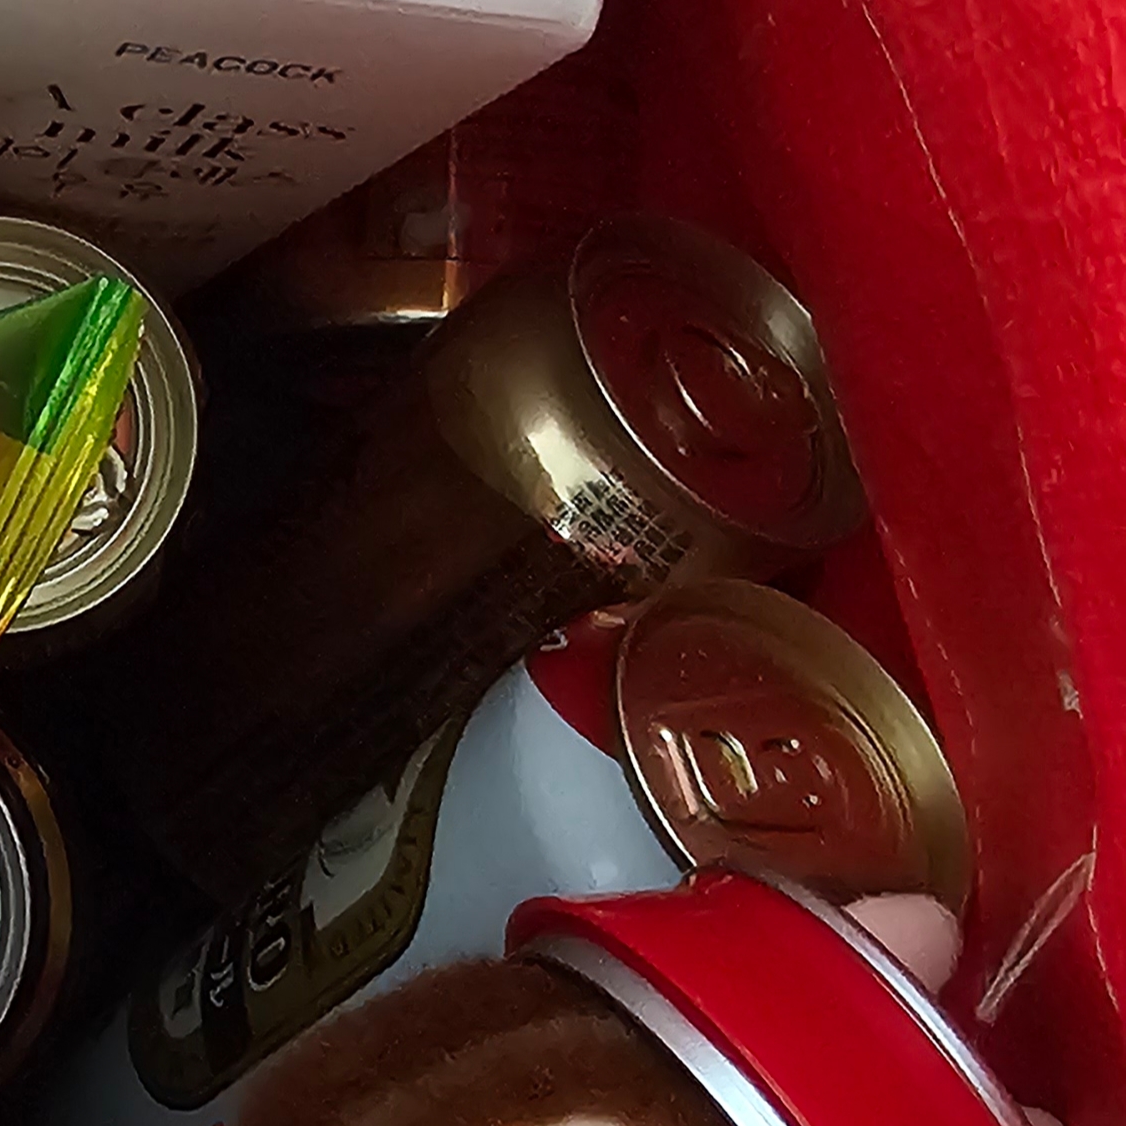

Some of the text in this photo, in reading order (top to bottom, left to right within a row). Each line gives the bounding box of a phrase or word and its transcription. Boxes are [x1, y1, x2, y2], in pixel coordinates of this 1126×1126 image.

[115, 41, 341, 84] PEACOCK
[38, 120, 246, 161] milk
[120, 103, 358, 140] class
